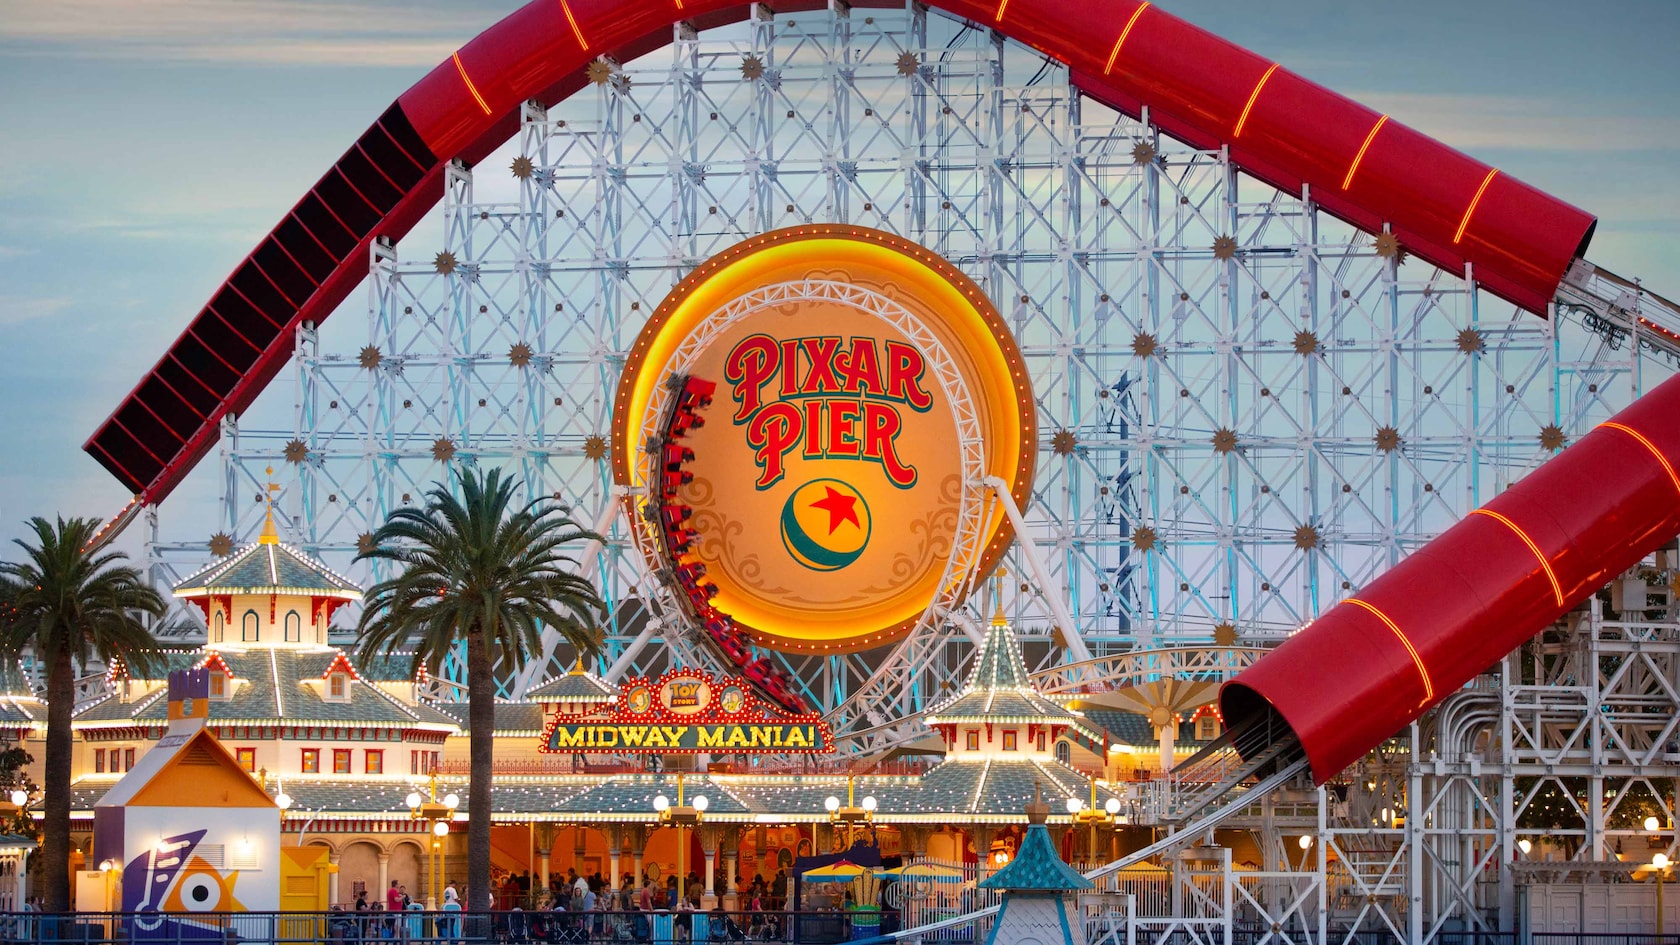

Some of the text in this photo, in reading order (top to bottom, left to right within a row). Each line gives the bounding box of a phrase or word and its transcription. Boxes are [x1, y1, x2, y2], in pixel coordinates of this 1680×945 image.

[724, 333, 933, 425] PIXAR
[746, 399, 918, 491] PIER
[670, 683, 701, 698] TOY
[557, 726, 815, 747] MIDWAY MANIA!
